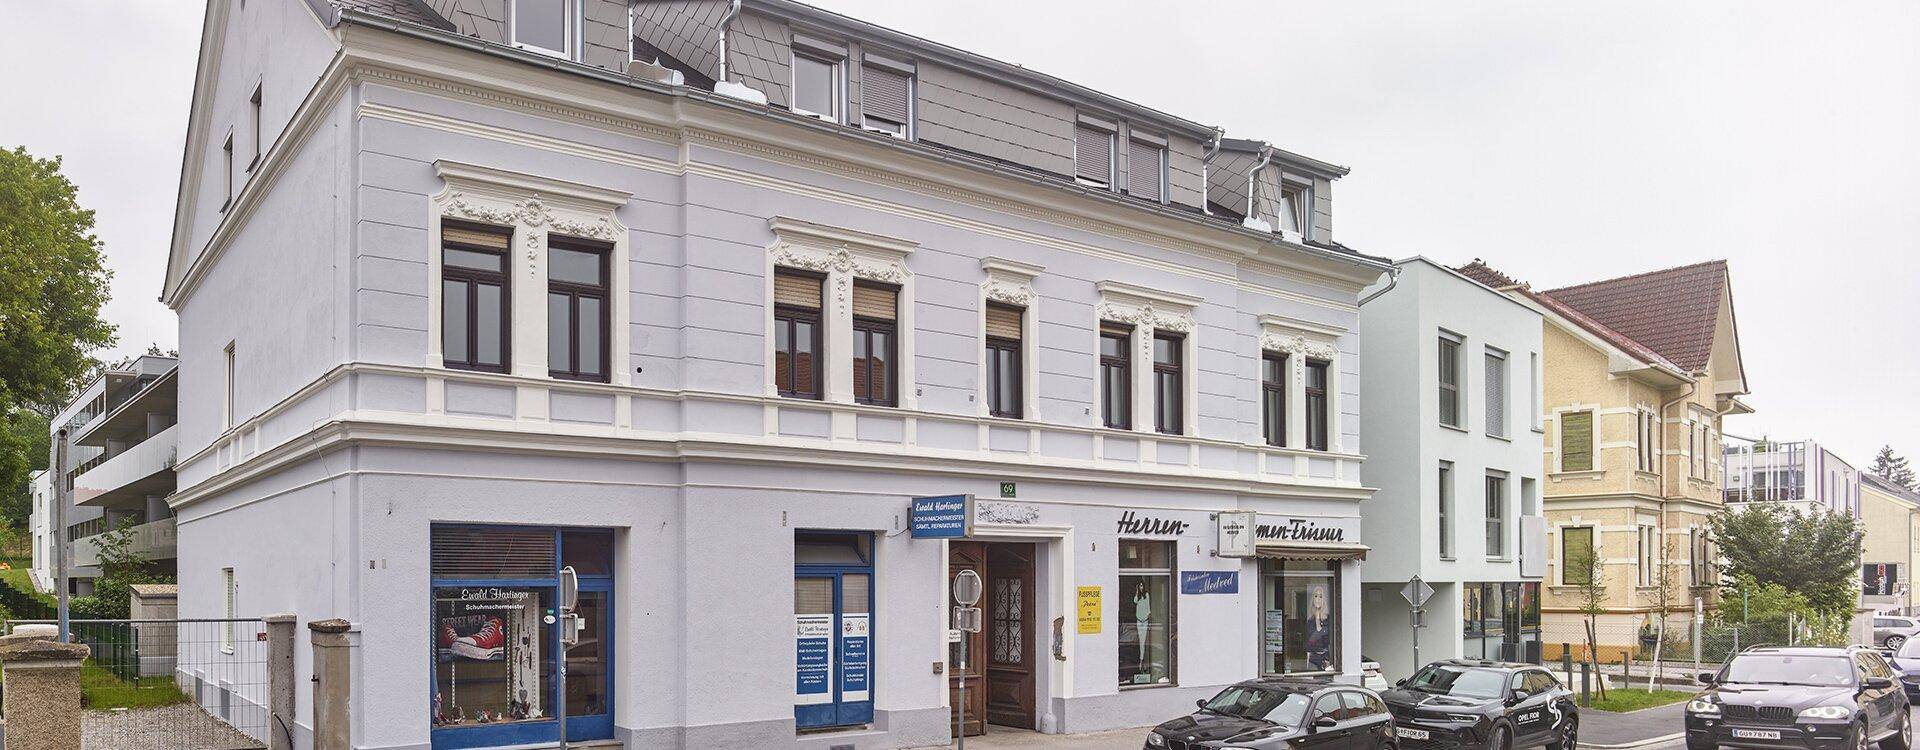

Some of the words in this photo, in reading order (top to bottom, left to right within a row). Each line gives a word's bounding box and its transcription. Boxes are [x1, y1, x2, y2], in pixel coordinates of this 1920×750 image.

[1003, 484, 1013, 493] 69
[915, 502, 934, 512] Ewald
[1117, 511, 1190, 535] Herren-
[1255, 519, 1344, 541] men-Friseur
[461, 588, 488, 600] Ewald
[465, 603, 525, 611] Schuhmachermeister
